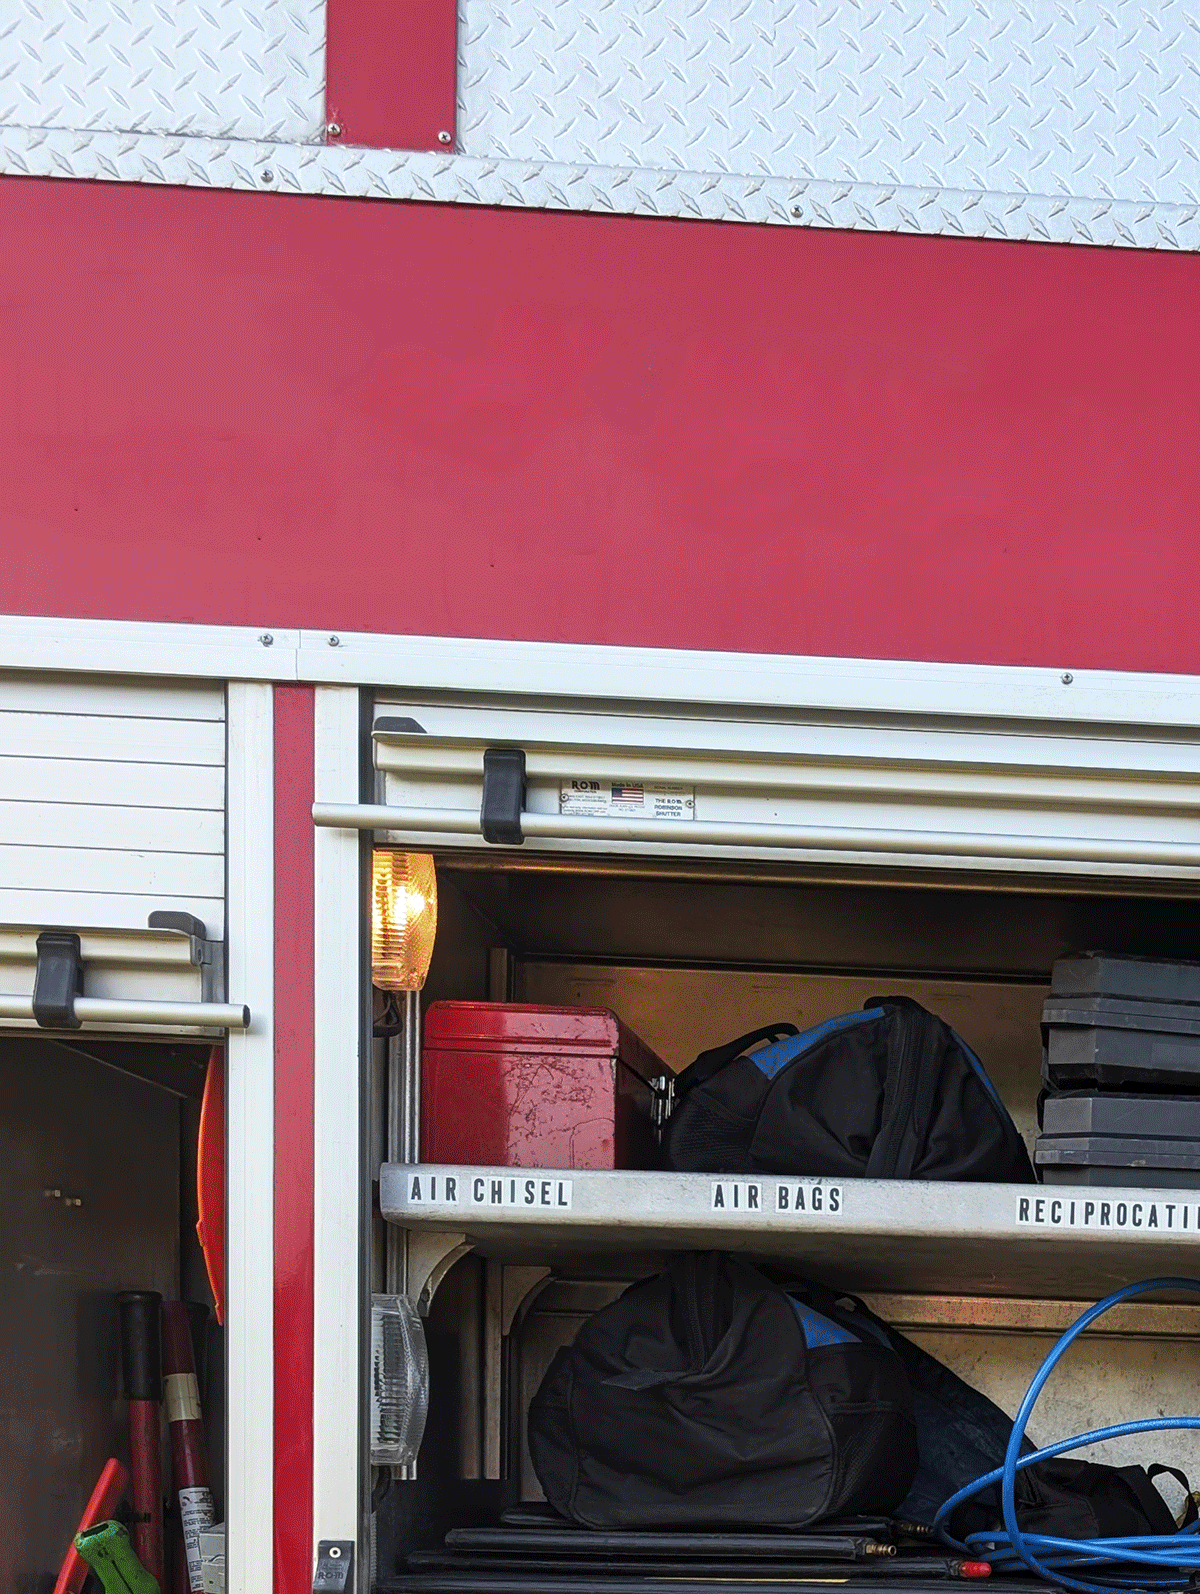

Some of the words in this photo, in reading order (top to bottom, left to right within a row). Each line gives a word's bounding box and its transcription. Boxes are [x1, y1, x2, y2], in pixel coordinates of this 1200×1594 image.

[410, 1176, 458, 1202] AIR
[473, 1177, 569, 1207] CHISEL
[713, 1183, 761, 1209] AIR
[777, 1184, 841, 1213] BAGS
